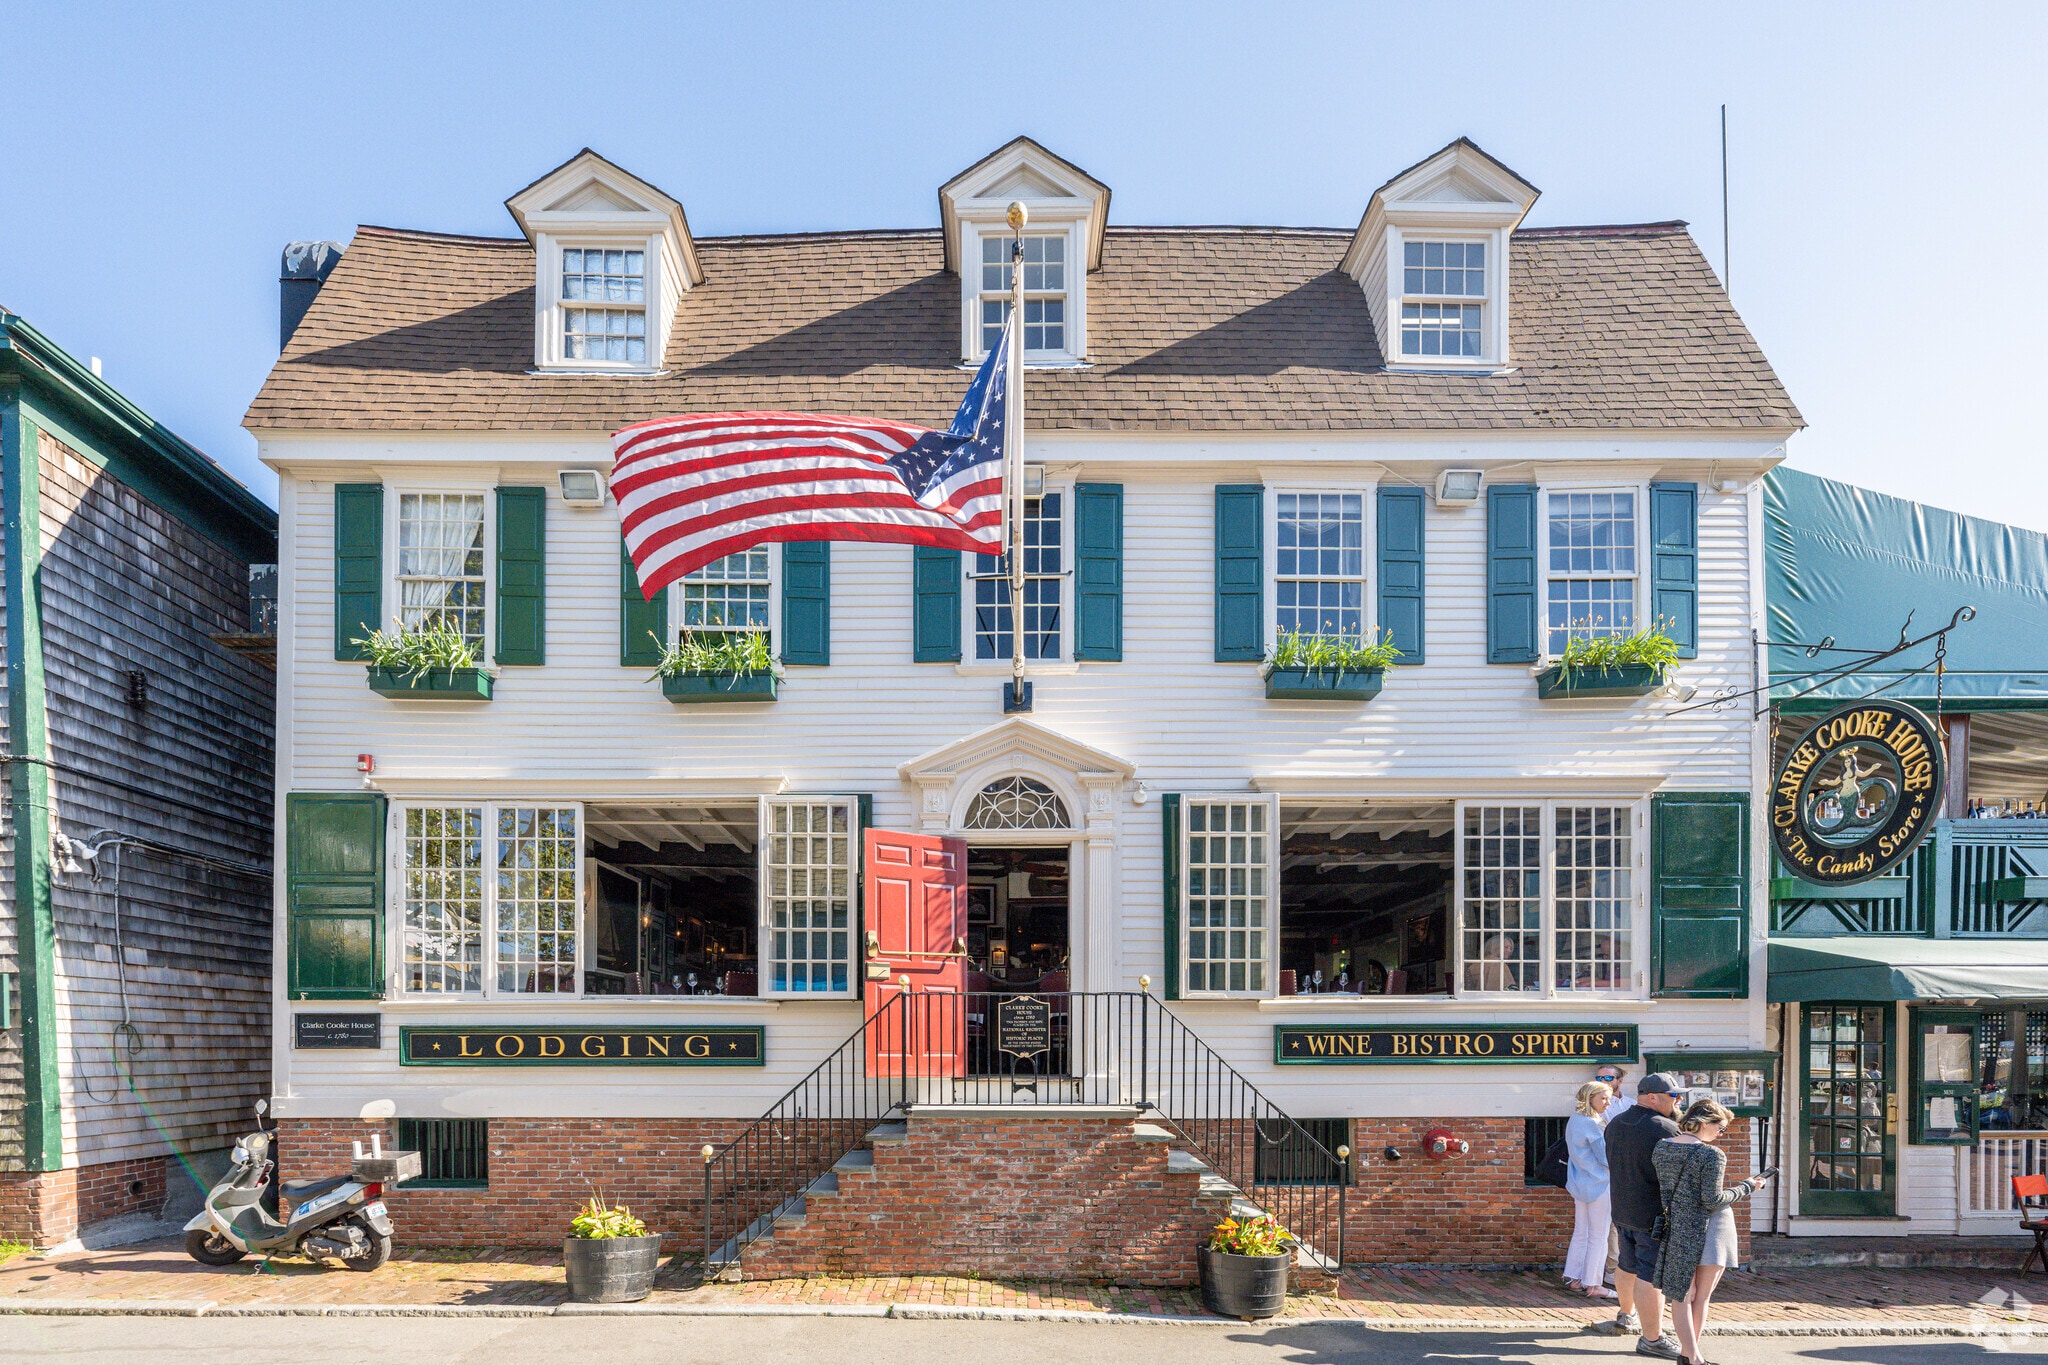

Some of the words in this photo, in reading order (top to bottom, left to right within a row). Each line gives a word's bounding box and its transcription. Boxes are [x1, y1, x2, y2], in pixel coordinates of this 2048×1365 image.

[1774, 740, 1821, 828] CLARKE
[1815, 710, 1893, 749] COOKE
[1884, 717, 1933, 792] HOUSE
[1787, 834, 1814, 866] The
[1816, 852, 1875, 874] Candy
[1878, 806, 1921, 858] Store
[334, 1032, 349, 1040] 1780
[458, 1035, 712, 1058] LODGING
[1304, 1034, 1373, 1056] WINE
[1391, 1033, 1495, 1056] BISTRO
